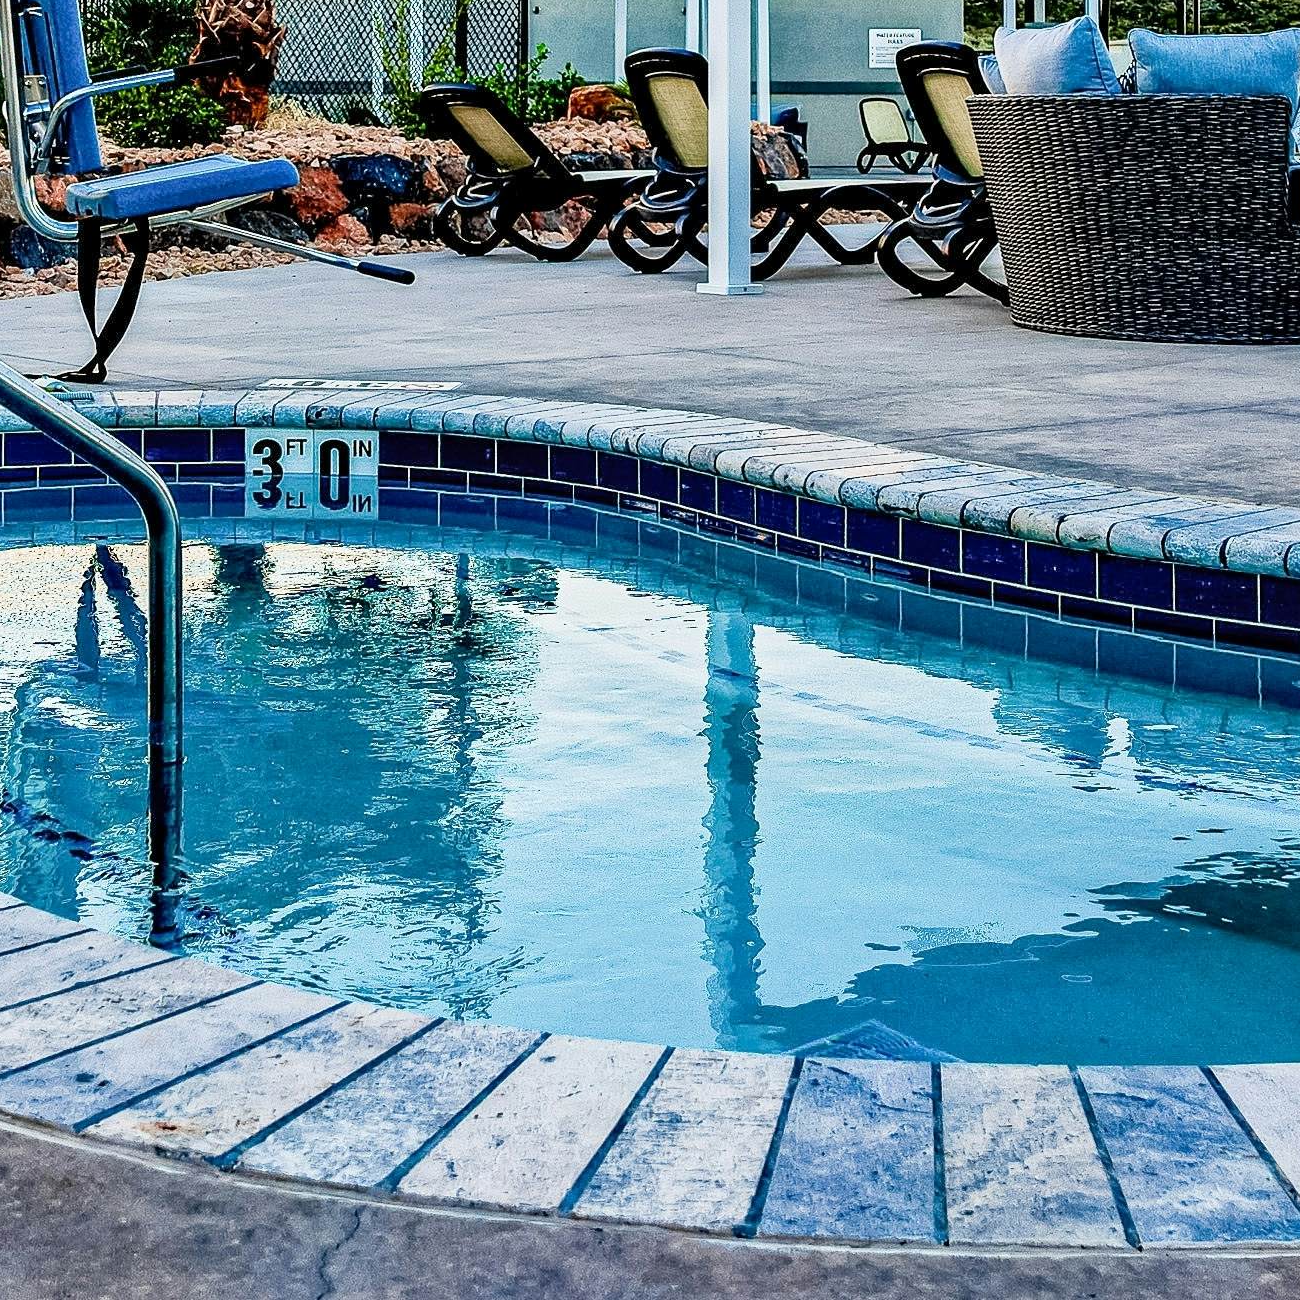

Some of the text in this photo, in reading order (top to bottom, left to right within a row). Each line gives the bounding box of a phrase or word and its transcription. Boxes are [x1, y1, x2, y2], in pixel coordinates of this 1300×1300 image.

[252, 438, 284, 477] 3
[286, 439, 308, 456] FT
[353, 439, 372, 458] IN
